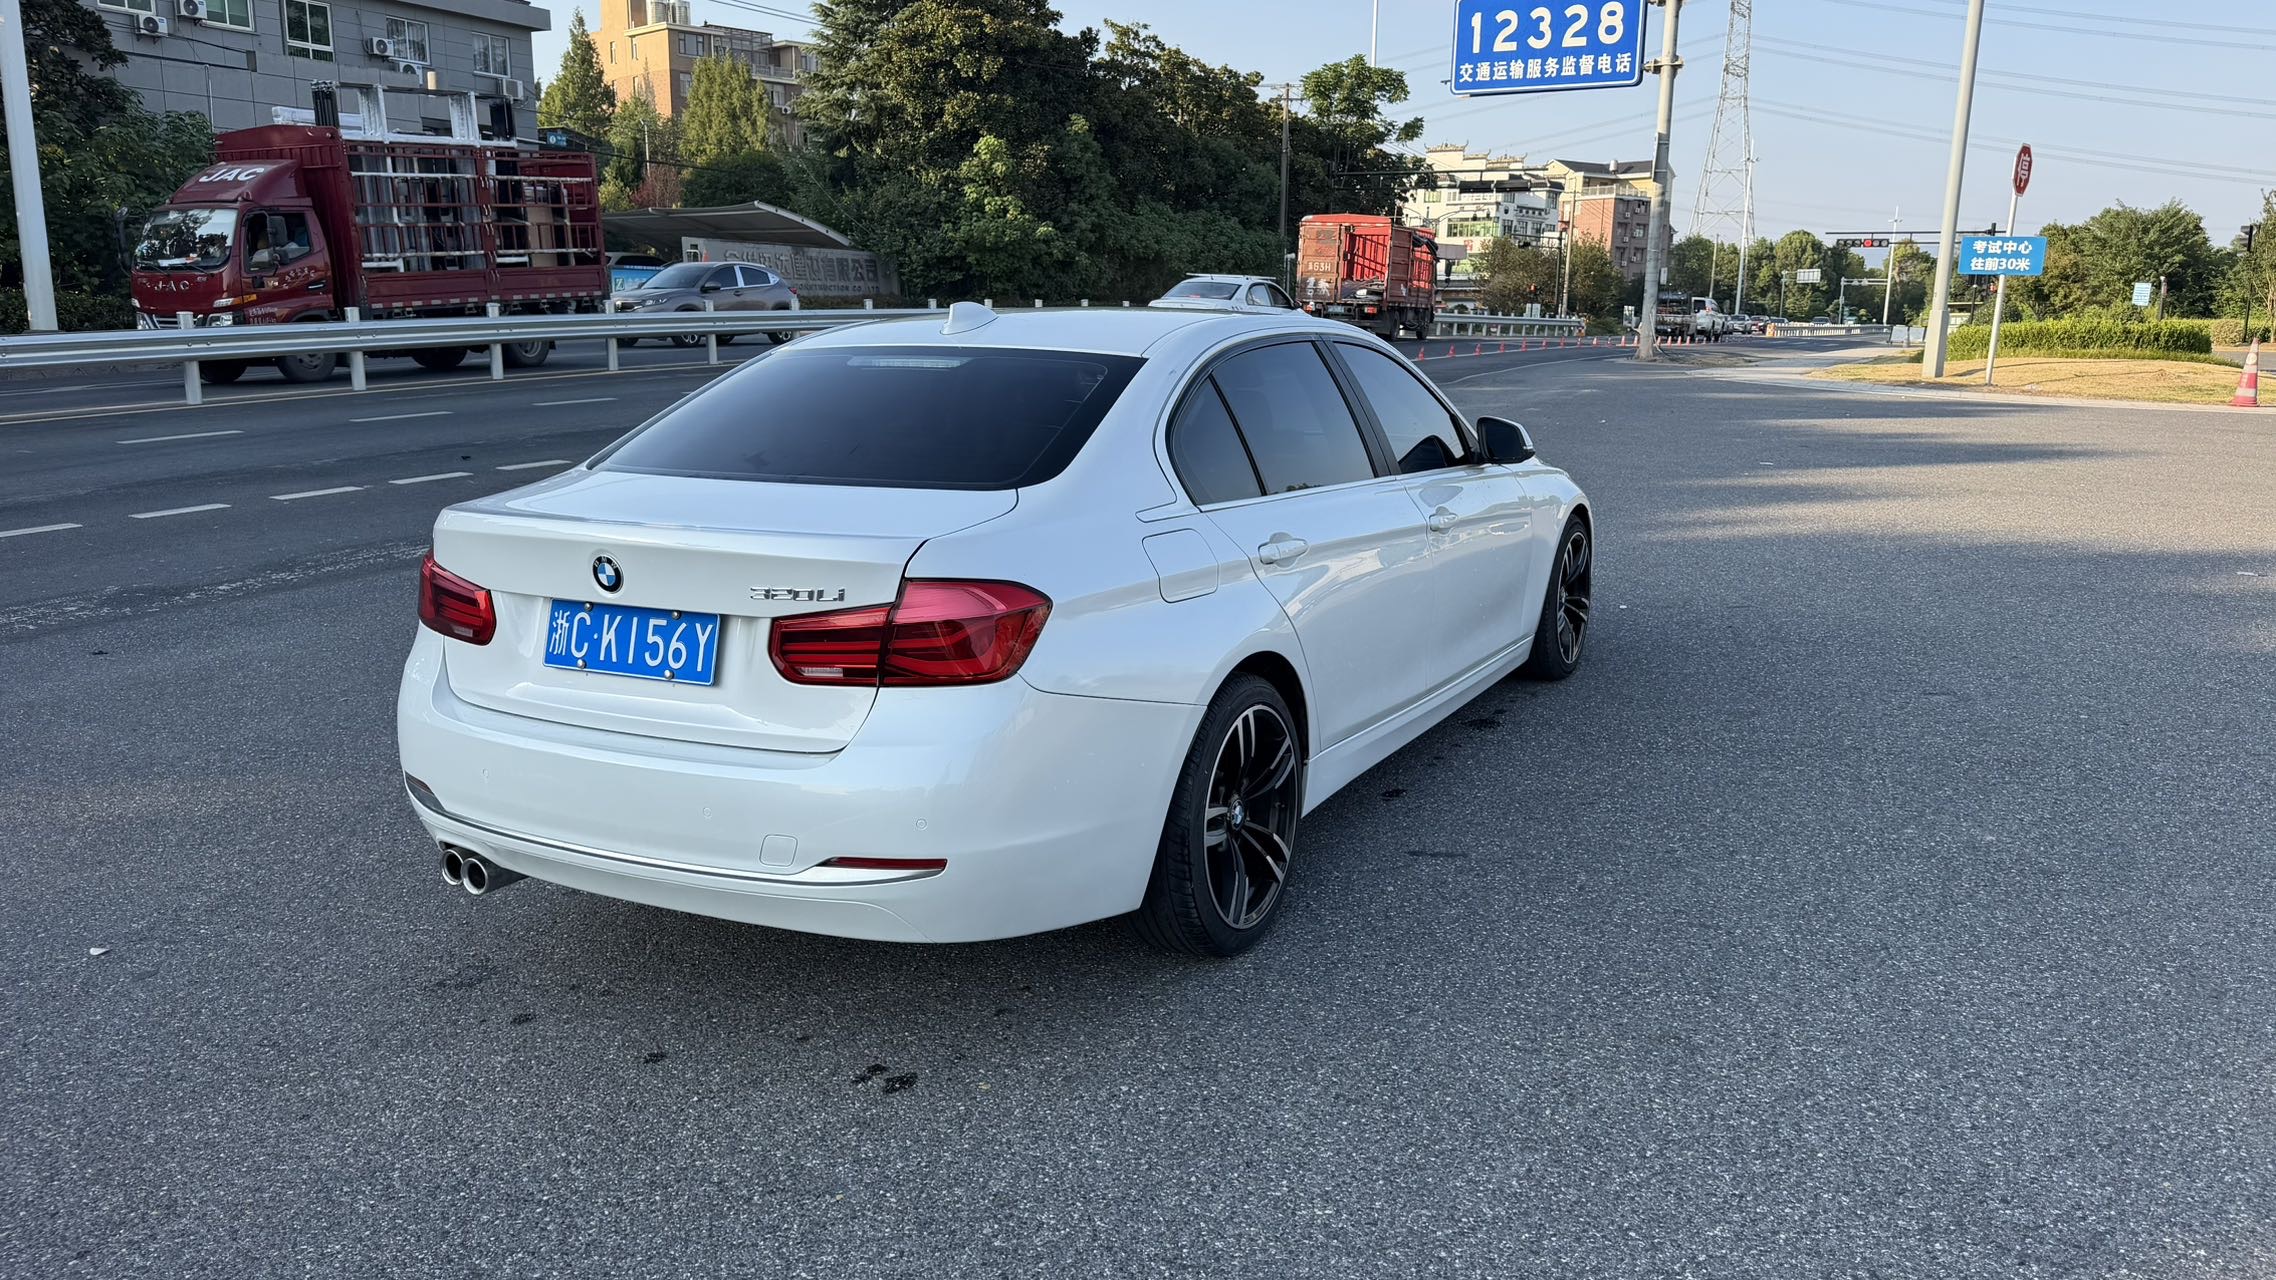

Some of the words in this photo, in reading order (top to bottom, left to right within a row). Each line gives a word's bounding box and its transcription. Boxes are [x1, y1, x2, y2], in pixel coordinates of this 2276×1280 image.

[1471, 1, 1624, 54] 12328
[1459, 52, 1632, 83] 交通运输服务监督电话
[199, 167, 264, 182] JAC
[2016, 153, 2030, 188] 停
[1972, 240, 2032, 255] 考试中心
[1970, 256, 2030, 271] 往前30米
[594, 555, 618, 570] BMW
[750, 587, 846, 602] 320Li
